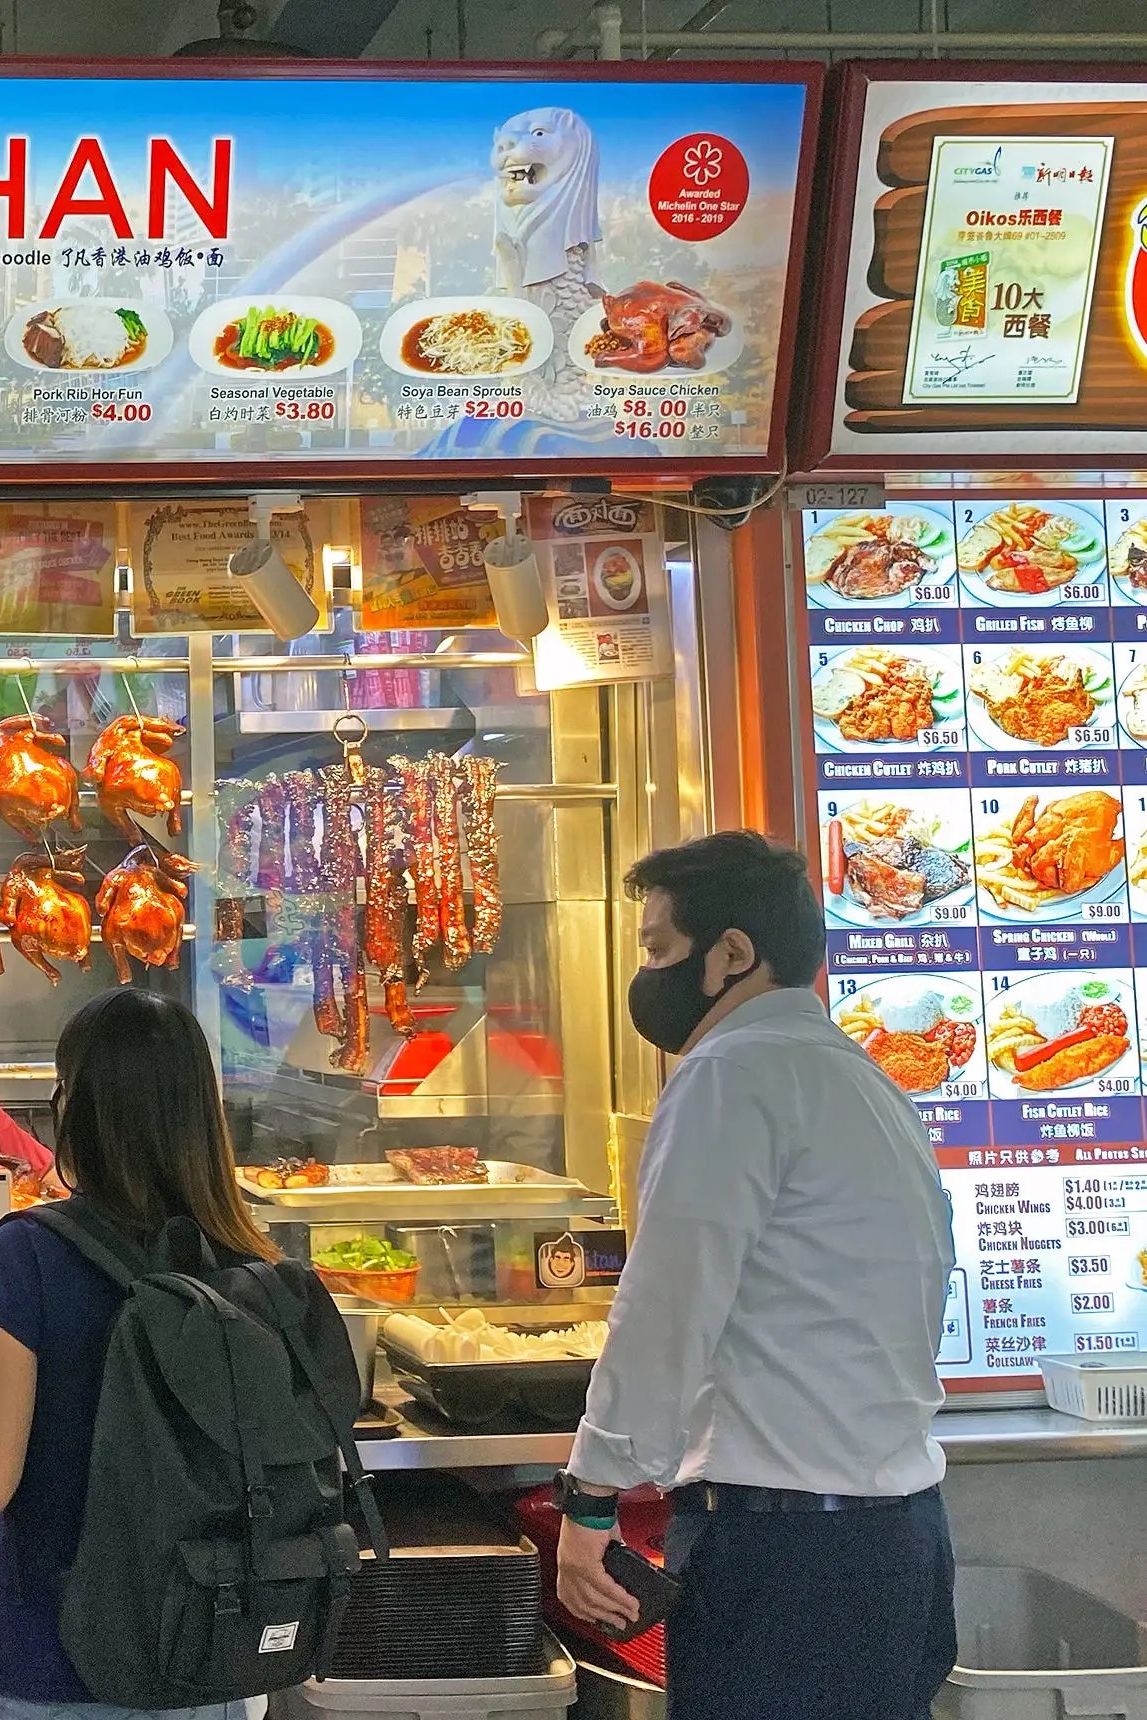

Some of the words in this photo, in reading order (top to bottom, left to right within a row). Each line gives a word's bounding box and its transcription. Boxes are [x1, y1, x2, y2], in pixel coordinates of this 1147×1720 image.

[953, 166, 993, 176] CITYGAS
[679, 188, 722, 199] Awarded
[657, 201, 697, 211] Michelin
[698, 201, 719, 211] One
[720, 201, 740, 211] Star
[671, 213, 694, 223] 2016
[700, 213, 724, 223] 2019
[1003, 313, 1052, 339] 西餐
[33, 388, 63, 401] Pork
[67, 388, 88, 401] Rib
[91, 388, 115, 401] Hor
[119, 388, 143, 401] Fun
[210, 387, 269, 399] Seasonal
[272, 387, 334, 401] Vegetable
[402, 386, 434, 400] Soya
[437, 386, 469, 398] Bean
[472, 386, 522, 400] Sprouts
[594, 385, 624, 399] Soya
[628, 385, 666, 396] Sauce
[669, 384, 719, 396] Chicken
[22, 406, 88, 424] 排骨河粉
[92, 404, 152, 422] $4.00
[275, 402, 334, 420] $3.80
[397, 404, 460, 420] 特色豆芽
[465, 400, 523, 418] $2.00
[587, 403, 618, 419] 油鸡
[691, 402, 721, 418] 半只
[614, 421, 686, 438] $16.00
[689, 424, 719, 440] 整只
[806, 488, 869, 506] 02-127
[964, 509, 973, 523] 2
[194, 531, 216, 540] Food
[219, 531, 254, 539] Awards
[914, 586, 950, 600] $6.00
[824, 617, 872, 633] CHICKEN
[873, 617, 904, 632] CHOP
[910, 616, 940, 633] 鸡扒
[975, 616, 1017, 631] GRILLED
[1019, 616, 1045, 631] FISH
[1051, 616, 1094, 632] 烤鱼柳
[922, 730, 958, 744] $6.50
[1074, 728, 1110, 743] $6.50
[823, 761, 871, 777] CHICKEN
[872, 760, 911, 776] CUTLET
[986, 759, 1017, 774] PORK
[1019, 759, 1058, 774] CUTLET
[827, 801, 838, 817] 9
[980, 799, 999, 814] 10
[934, 907, 967, 920] $9.00
[848, 934, 883, 949] MIXED
[884, 933, 915, 948] GRILL
[992, 929, 1030, 944] SPRING
[1031, 928, 1075, 943] CHICKEN
[837, 979, 857, 995] 13
[991, 976, 1011, 991] 14
[945, 1083, 978, 1098] $4.00
[1098, 1079, 1130, 1093] $4.00
[934, 1106, 960, 1121] RICE
[1022, 1104, 1046, 1119] FISH
[1047, 1103, 1083, 1118] CUTLET
[1084, 1102, 1110, 1117] RICE
[1039, 1123, 1095, 1139] 炸鱼柳饭
[1065, 1179, 1101, 1194] $1.40
[976, 1201, 1016, 1215] CHICKEN
[1017, 1200, 1051, 1214] WINGS
[1066, 1195, 1103, 1211] $4.00
[977, 1220, 1023, 1236] 炸鸡块
[1068, 1220, 1105, 1236] $3.00
[979, 1238, 1018, 1252] CHICKEN
[1020, 1236, 1062, 1250] NUGGETS
[979, 1259, 1041, 1276] 芝士薯条
[1071, 1257, 1108, 1275] $3.50
[981, 1276, 1015, 1290] CHEESE
[1017, 1275, 1043, 1290] FRIES
[982, 1298, 1014, 1314] 薯条
[1074, 1294, 1111, 1311] $2.00
[983, 1315, 1018, 1329] FRENCH
[1020, 1314, 1046, 1328] FRIES
[1076, 1335, 1113, 1351] $1.50
[986, 1354, 1035, 1368] COLESLAW
